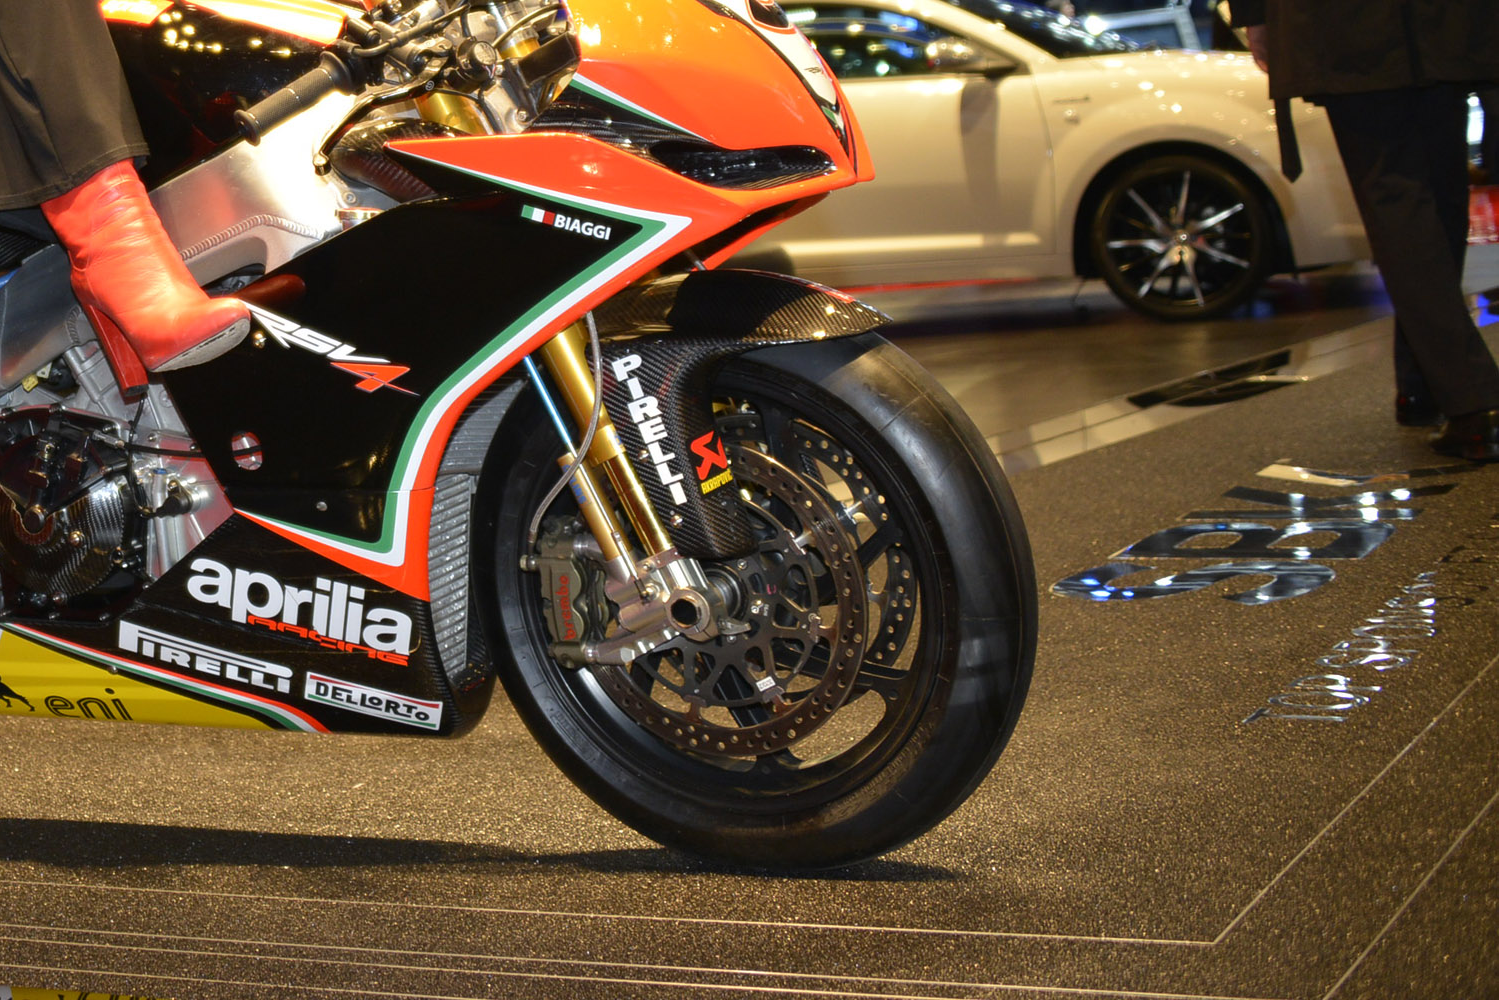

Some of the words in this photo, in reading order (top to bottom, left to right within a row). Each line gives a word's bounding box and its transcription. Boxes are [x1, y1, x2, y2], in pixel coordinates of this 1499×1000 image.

[553, 213, 612, 241] BIAGGI
[611, 353, 688, 506] PIRELLI
[1051, 484, 1459, 606] SBK
[187, 557, 413, 656] aprilia
[555, 575, 576, 641] brembo
[118, 619, 294, 694] PIRELLI
[45, 688, 134, 720] eni
